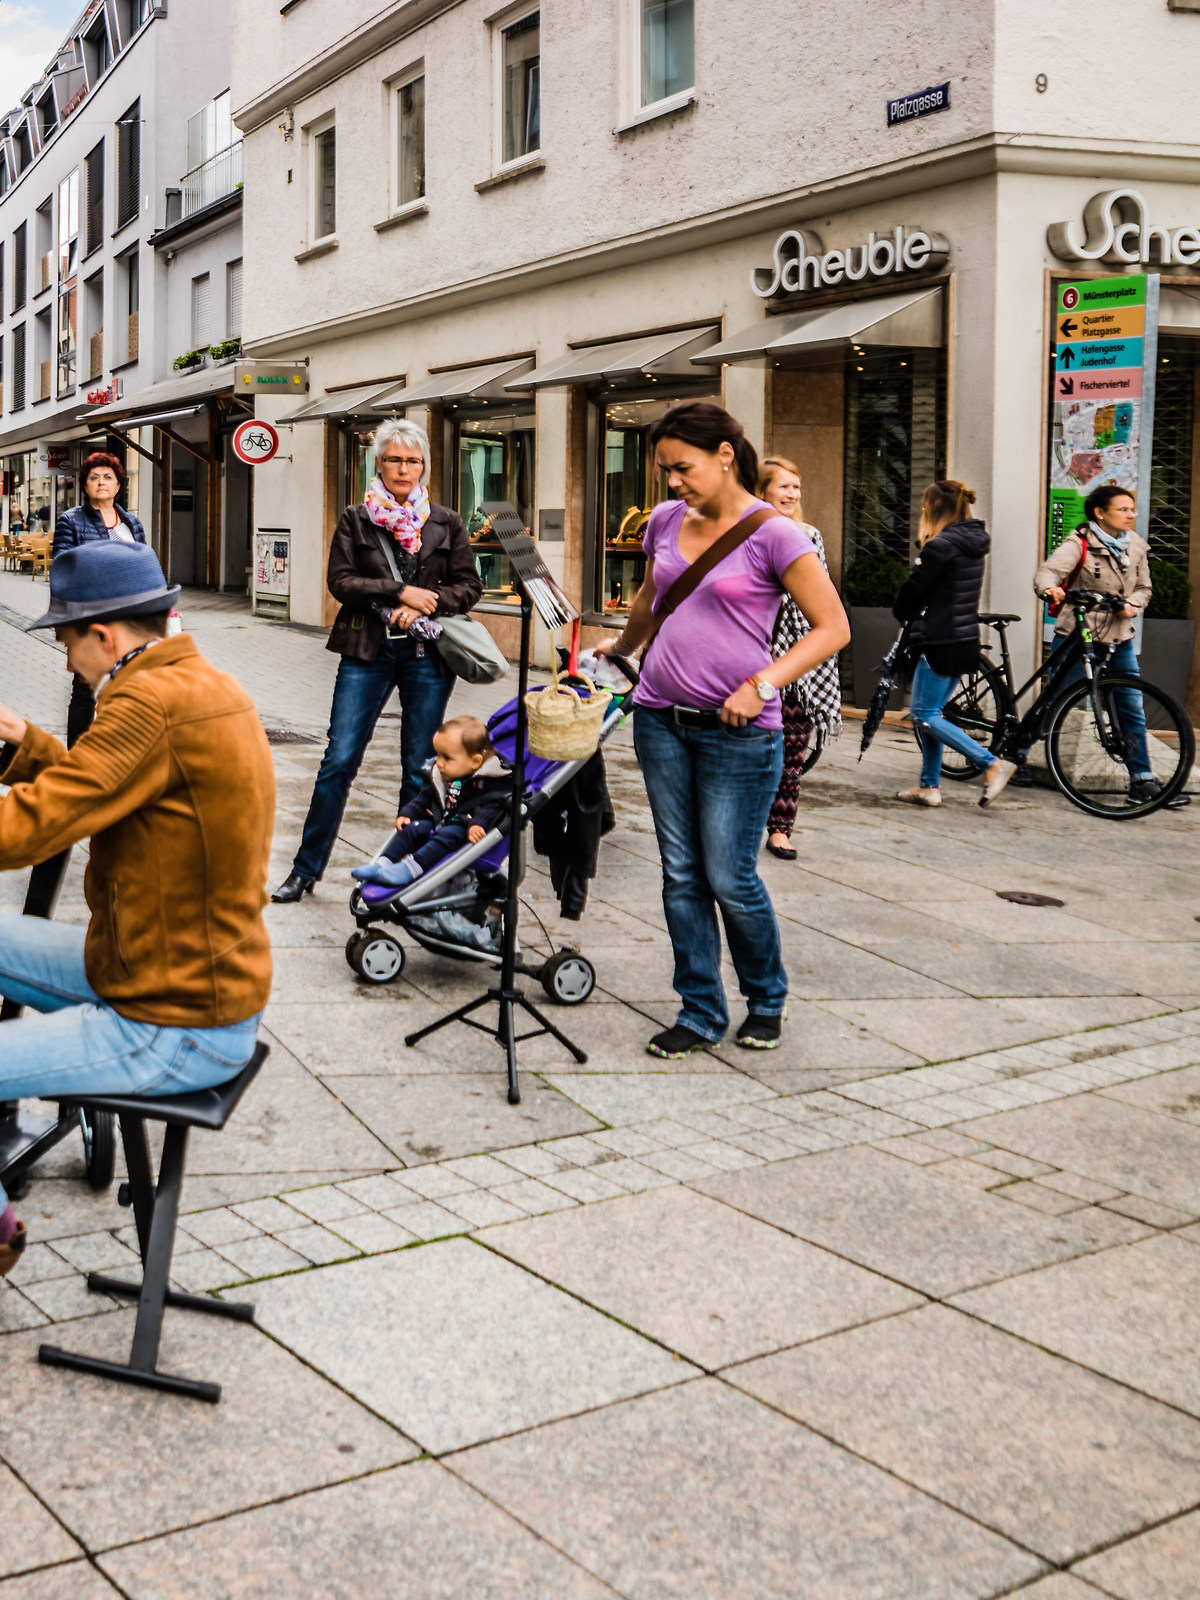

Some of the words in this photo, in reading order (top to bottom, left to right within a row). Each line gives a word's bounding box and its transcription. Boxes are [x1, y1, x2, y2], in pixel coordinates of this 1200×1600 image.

[890, 91, 943, 120] Platzgasse
[751, 226, 936, 297] Scheuble
[1066, 293, 1075, 304] 6
[1083, 287, 1137, 301] Münsterplatz
[1082, 314, 1115, 325] Quartier
[1082, 327, 1122, 337] Platzgasse
[1081, 344, 1126, 355] Hafengasse
[1080, 356, 1117, 367] Judenhof
[256, 375, 288, 384] ROLEX
[1080, 379, 1131, 390] Fischerviertel
